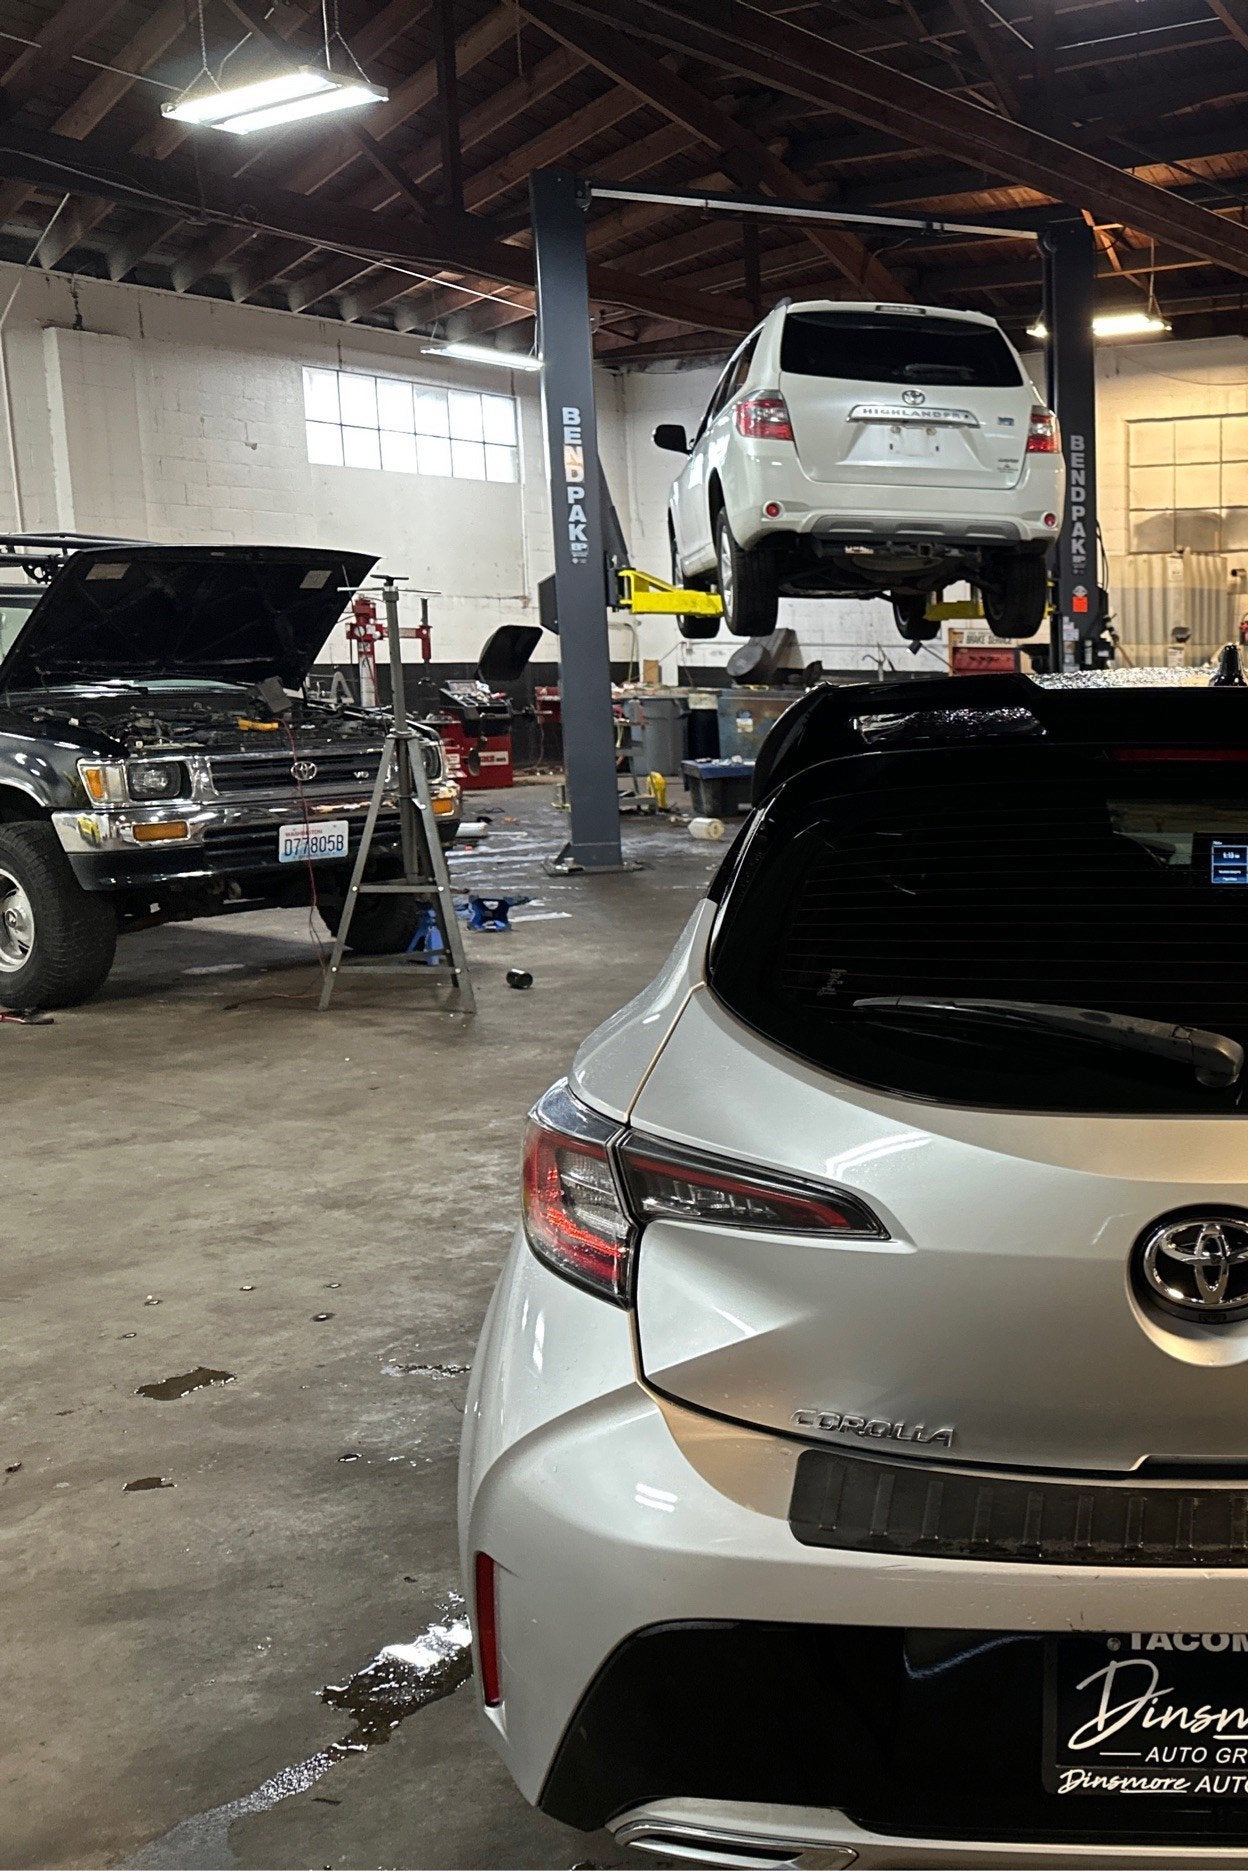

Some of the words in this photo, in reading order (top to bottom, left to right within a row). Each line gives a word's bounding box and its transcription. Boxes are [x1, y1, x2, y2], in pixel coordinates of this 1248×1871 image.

[863, 409, 960, 419] HIGHLANDER
[562, 407, 588, 541] BENDPAK
[1070, 435, 1085, 554] BENDPAK
[285, 834, 344, 857] D77805B
[791, 1409, 954, 1447] COROLLA
[1145, 1747, 1208, 1763] AUTO
[1057, 1769, 1191, 1794] Dinsmore
